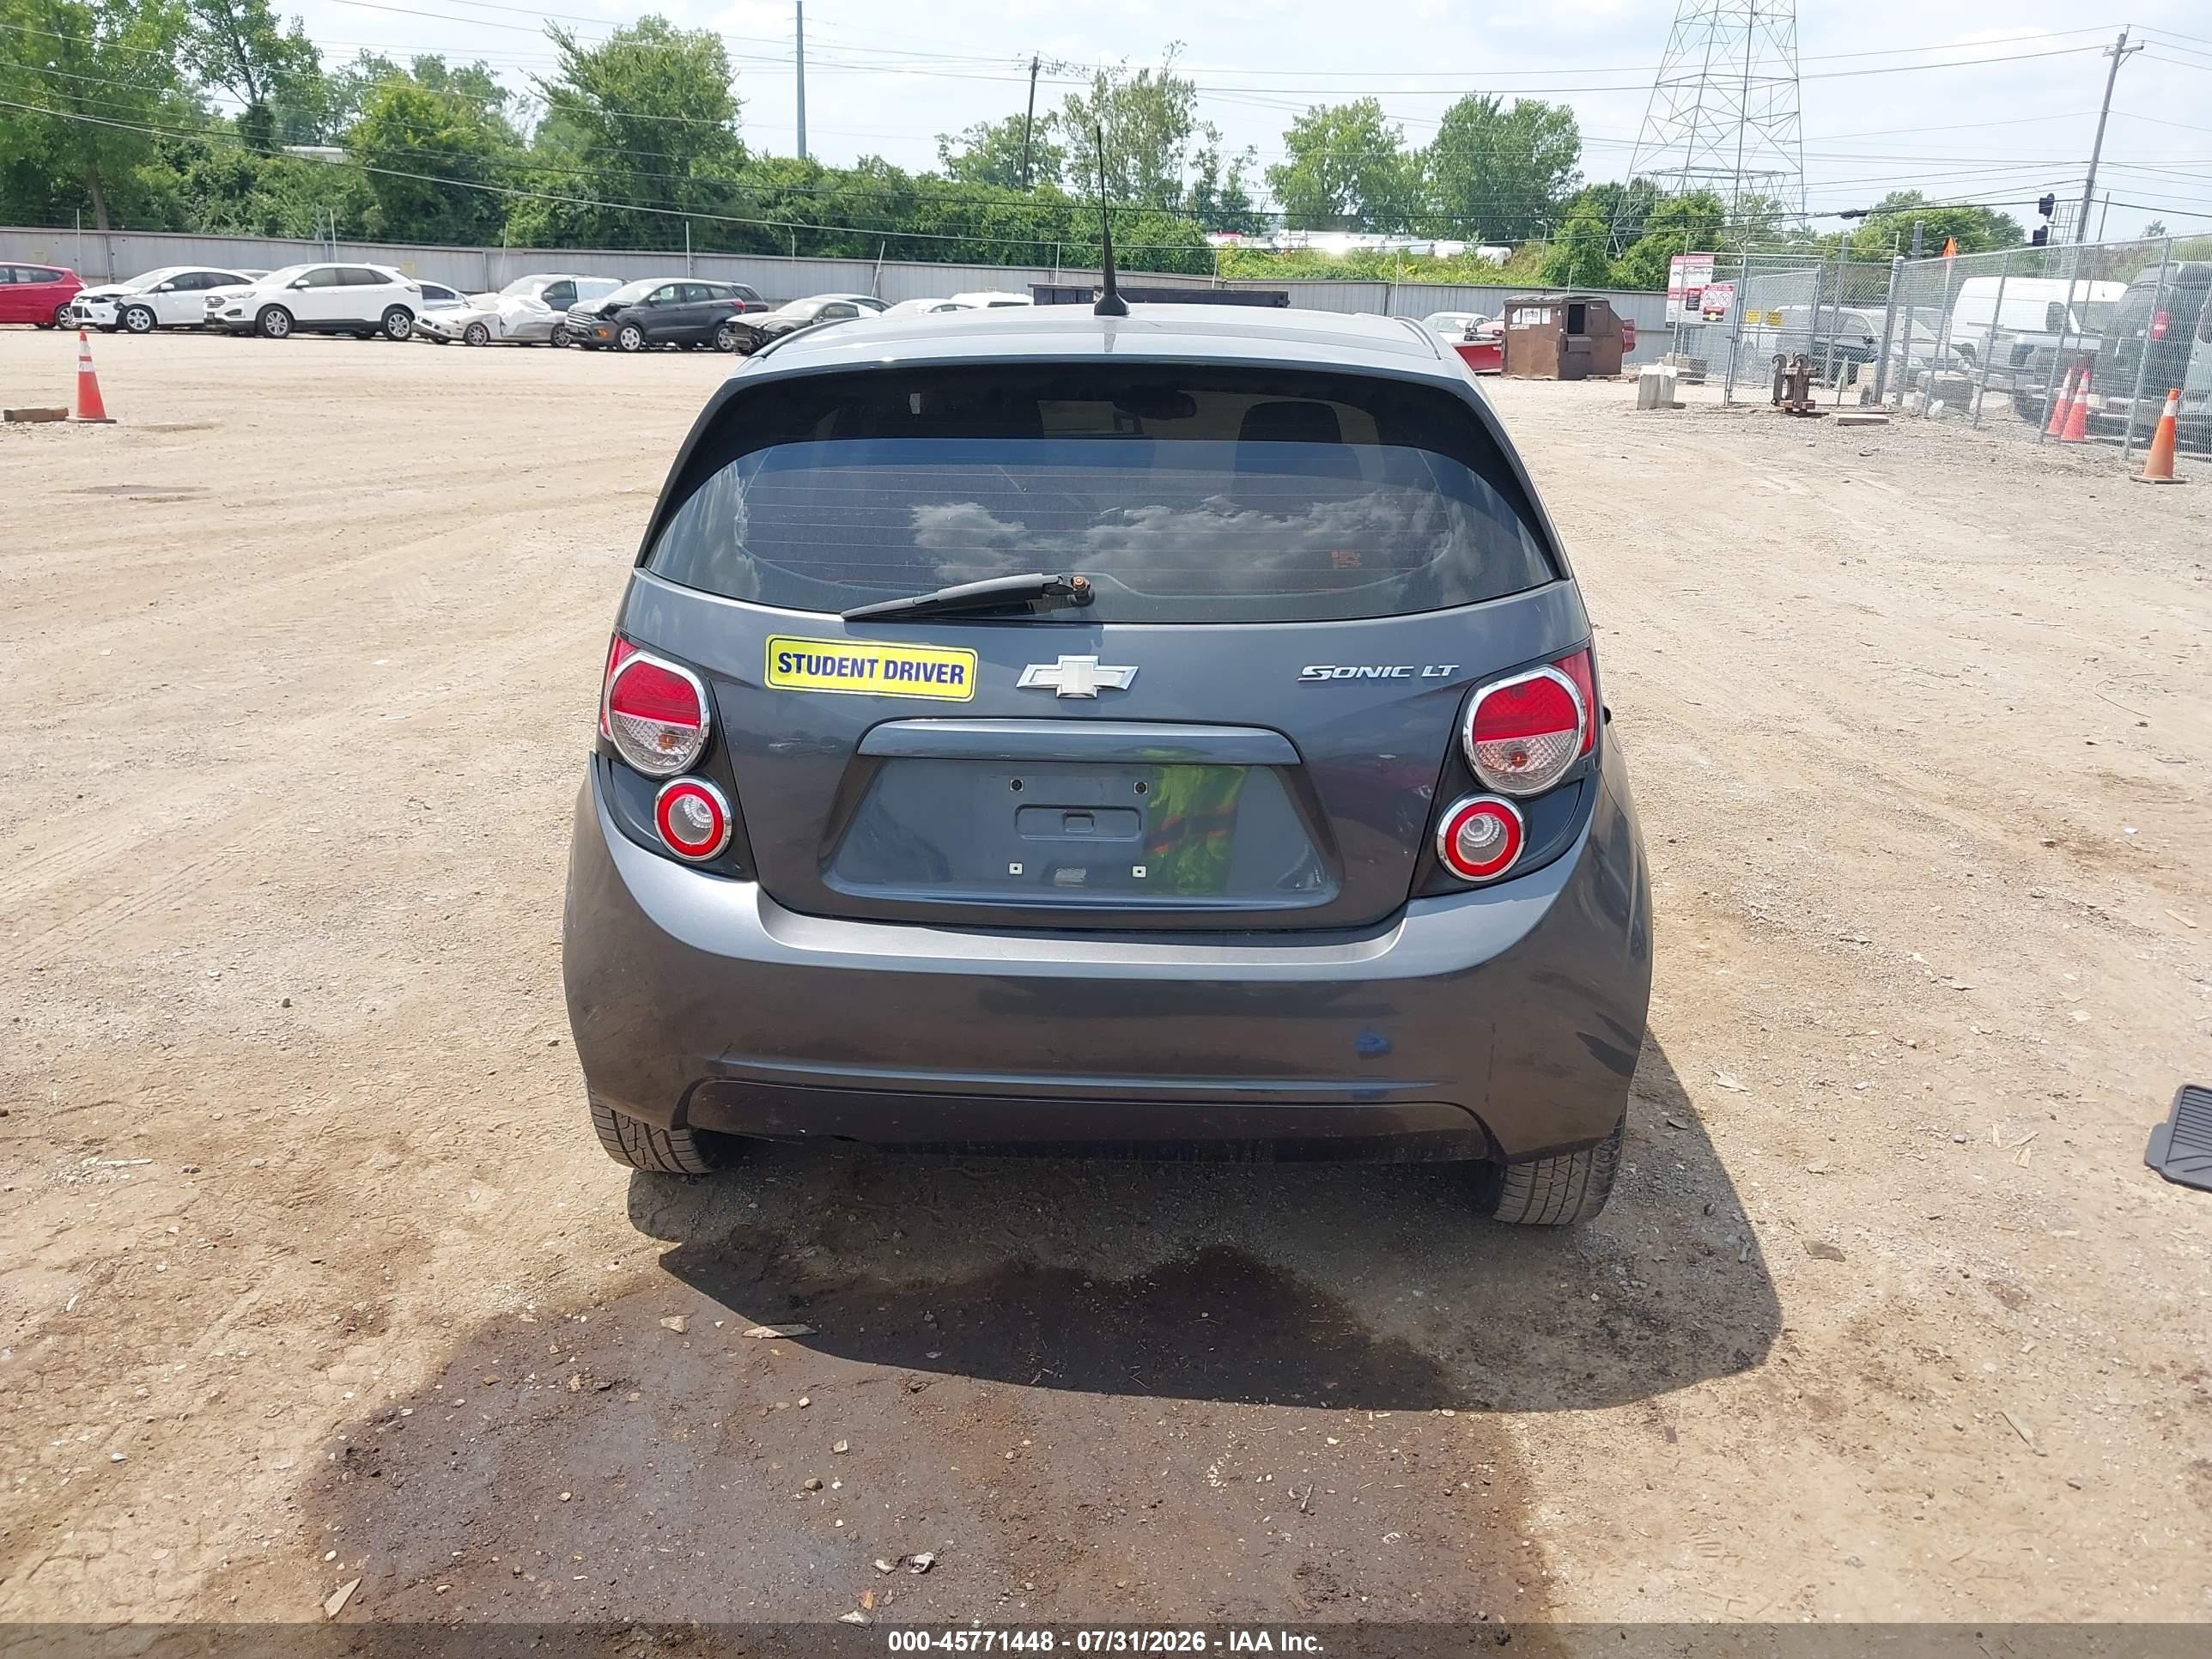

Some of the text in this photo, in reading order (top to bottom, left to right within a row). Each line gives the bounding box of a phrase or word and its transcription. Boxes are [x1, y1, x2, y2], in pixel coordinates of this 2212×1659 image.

[777, 652, 964, 685] STUDENT DRIVER
[1297, 665, 1460, 681] SONIC LT
